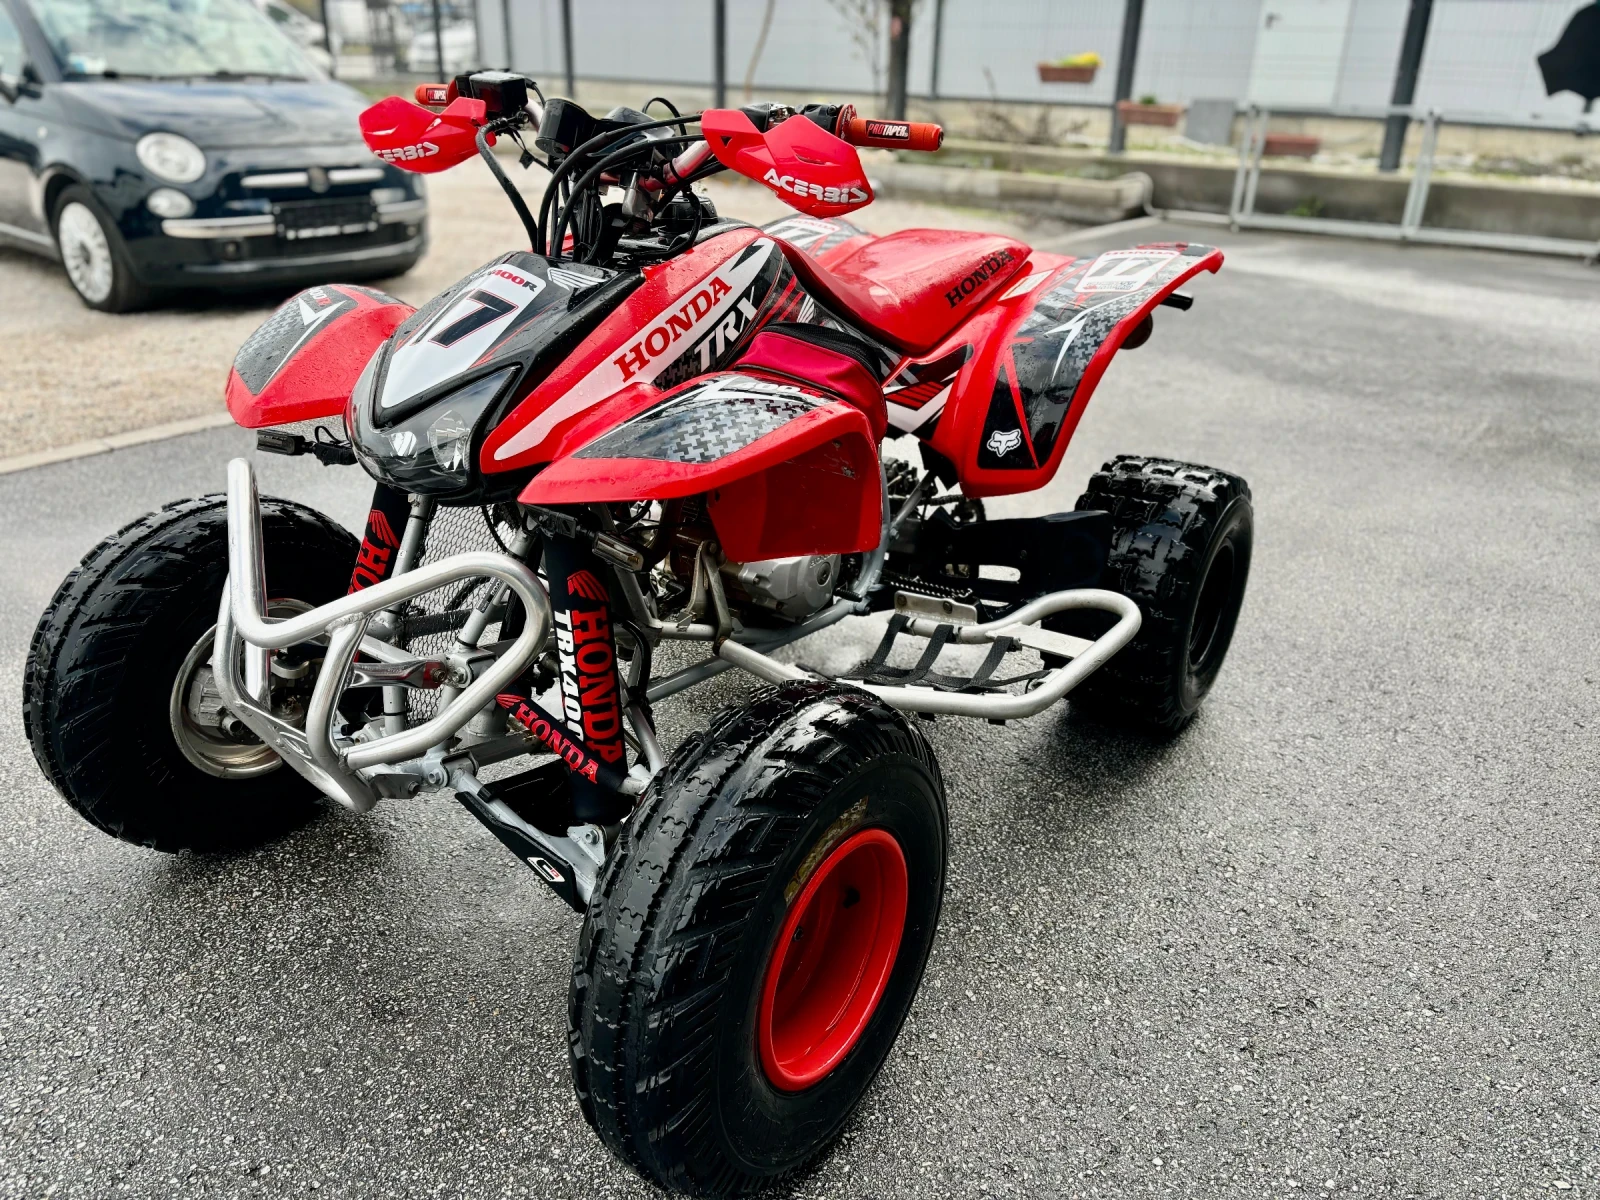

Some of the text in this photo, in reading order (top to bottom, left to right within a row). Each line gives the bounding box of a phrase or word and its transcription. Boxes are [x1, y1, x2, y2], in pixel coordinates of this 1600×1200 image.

[373, 141, 440, 162] CERBIS
[763, 167, 868, 203] ACERBIS
[944, 248, 1016, 308] HONDA
[613, 275, 733, 383] HONDA
[694, 285, 761, 373] TRX
[511, 702, 600, 785] HONDA
